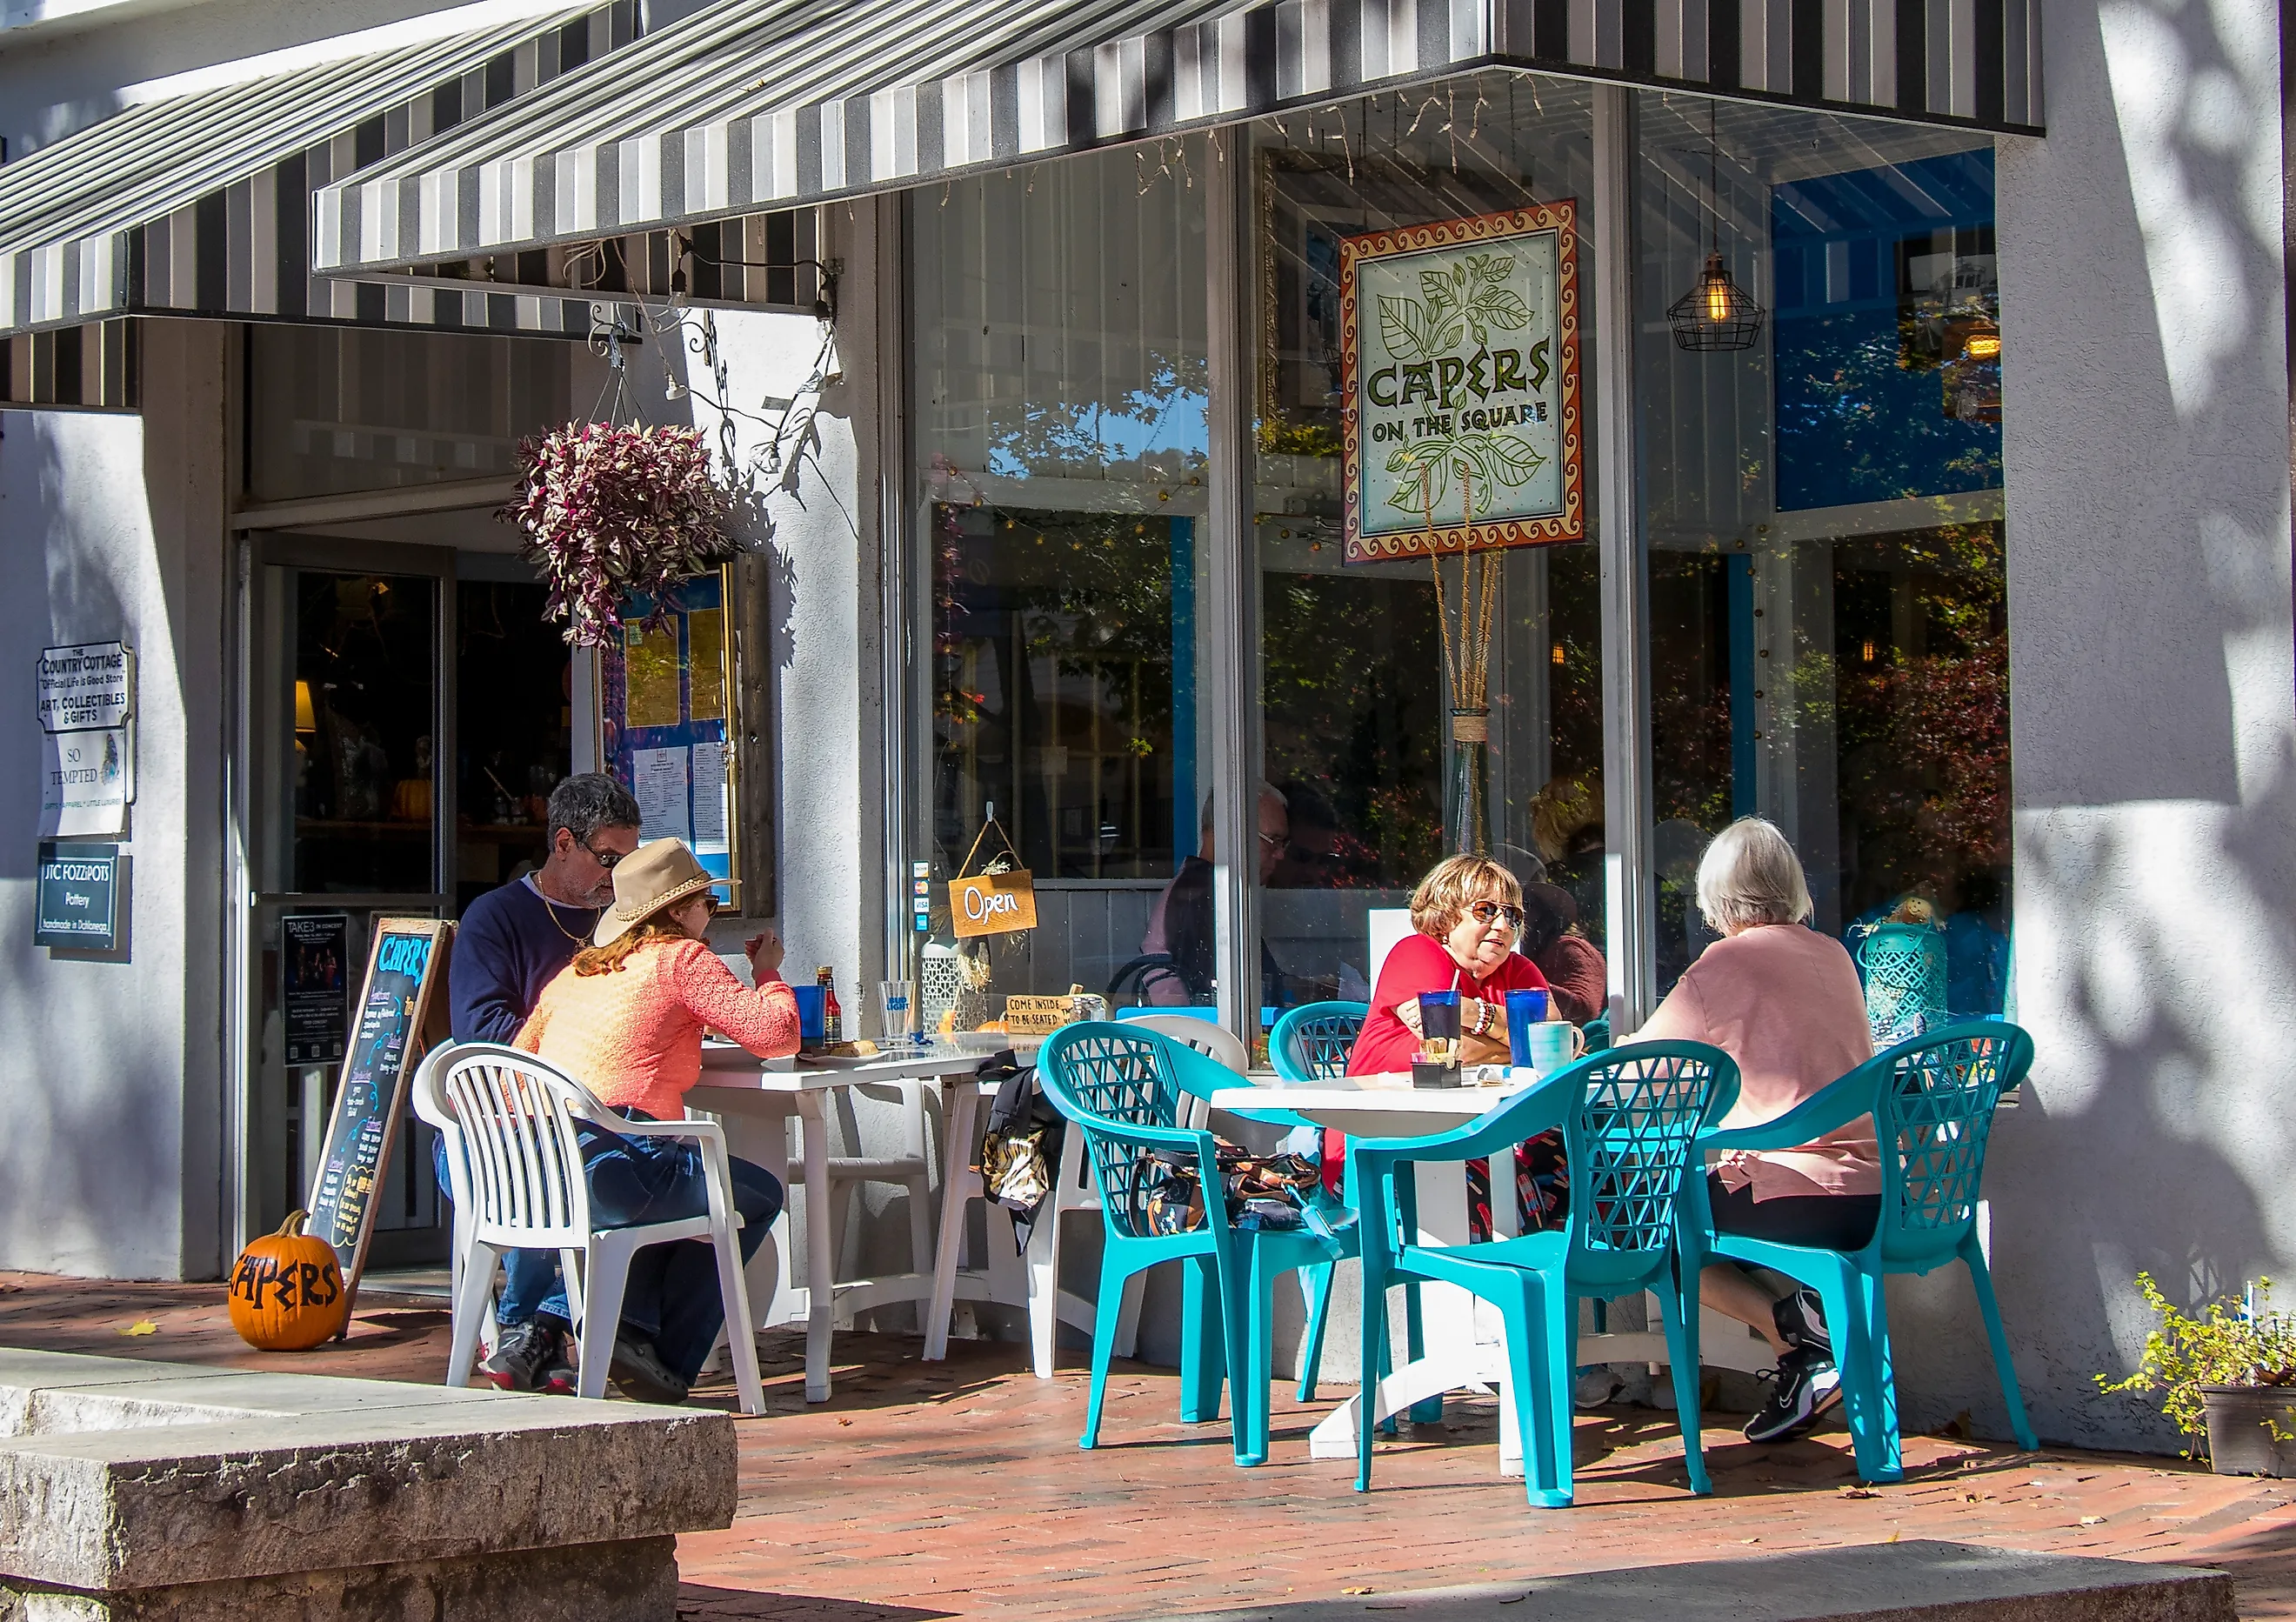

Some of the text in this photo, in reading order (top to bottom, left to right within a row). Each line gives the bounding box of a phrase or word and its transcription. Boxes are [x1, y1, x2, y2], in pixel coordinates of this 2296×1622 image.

[1366, 335, 1551, 410] CAPERS
[1372, 401, 1548, 443] ON THE SQUARE
[42, 652, 123, 675] COUNTRY COTTAGE
[87, 674, 104, 685] Good
[40, 692, 125, 712] ART, COLLECTIBLES
[63, 709, 97, 724] & GIFTS
[67, 748, 81, 763] SO
[50, 768, 97, 784] TEMPTED
[45, 864, 62, 880] JTC
[65, 891, 90, 909] Pottery
[964, 885, 1018, 925] Open
[43, 918, 108, 932] handmade in Dahlonega
[287, 921, 315, 933] TAKE3
[377, 935, 433, 988] CAPERS
[1010, 998, 1059, 1010] COME INSIDE
[1010, 1015, 1020, 1025] TO
[1022, 1014, 1030, 1025] BE
[1032, 1014, 1058, 1025] SEATED
